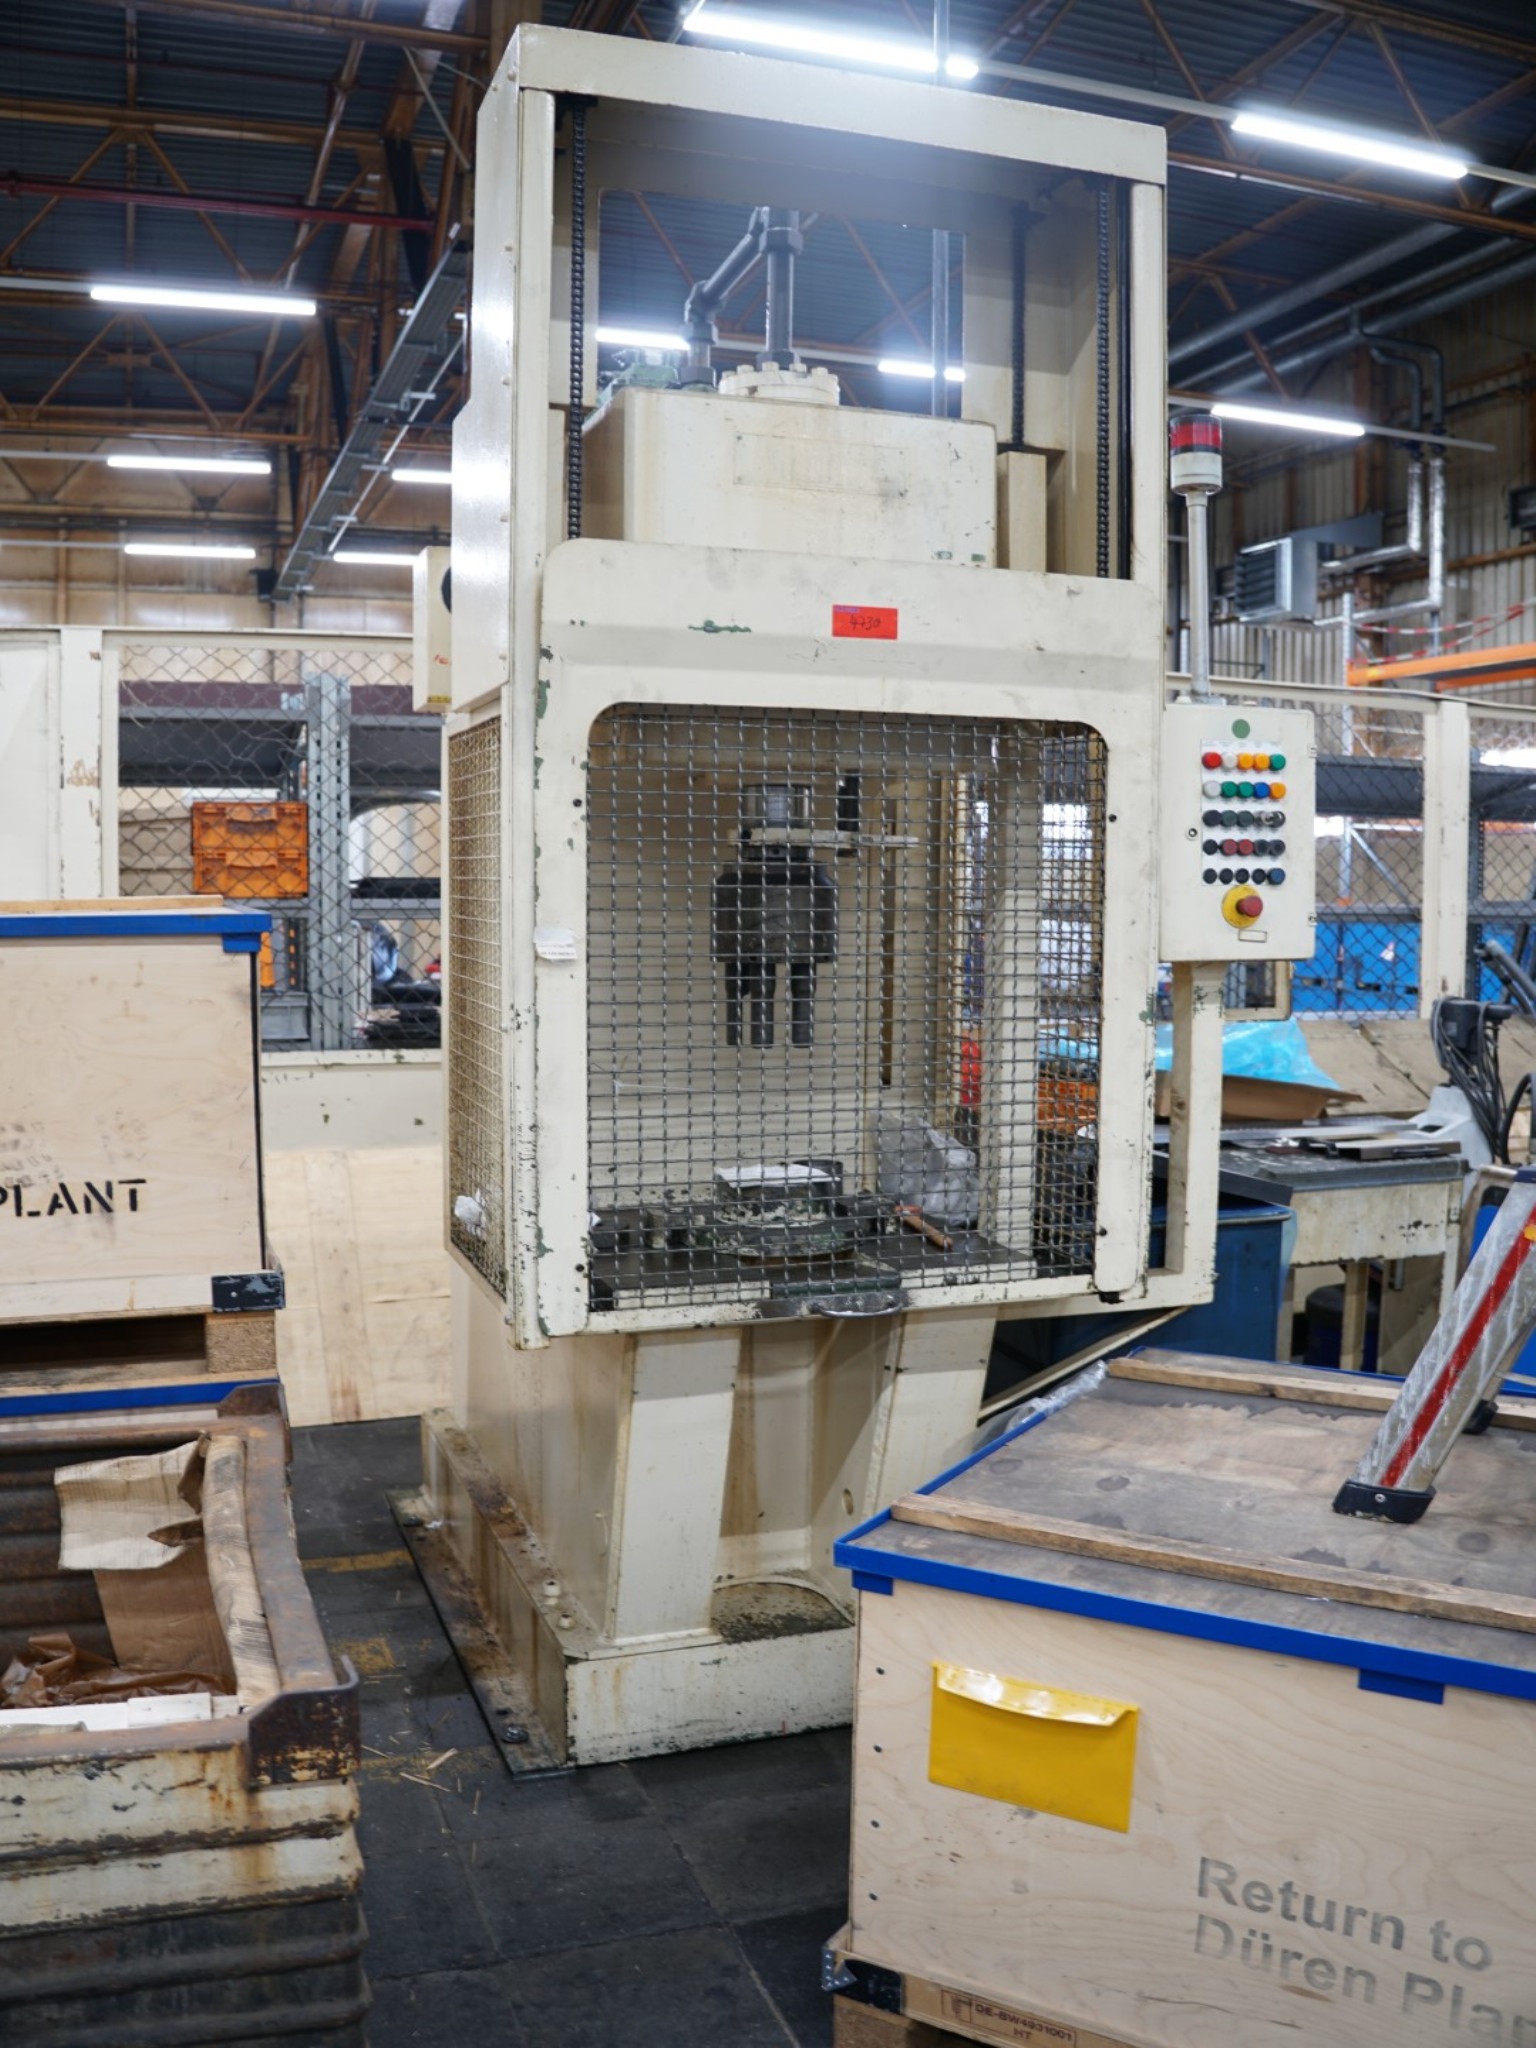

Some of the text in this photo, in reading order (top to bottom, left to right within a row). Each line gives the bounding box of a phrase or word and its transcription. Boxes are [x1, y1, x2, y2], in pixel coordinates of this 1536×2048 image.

[1194, 1913, 1377, 2004] Düren
[1197, 1856, 1493, 1972] Return to
[1013, 2027, 1033, 2040] HT
